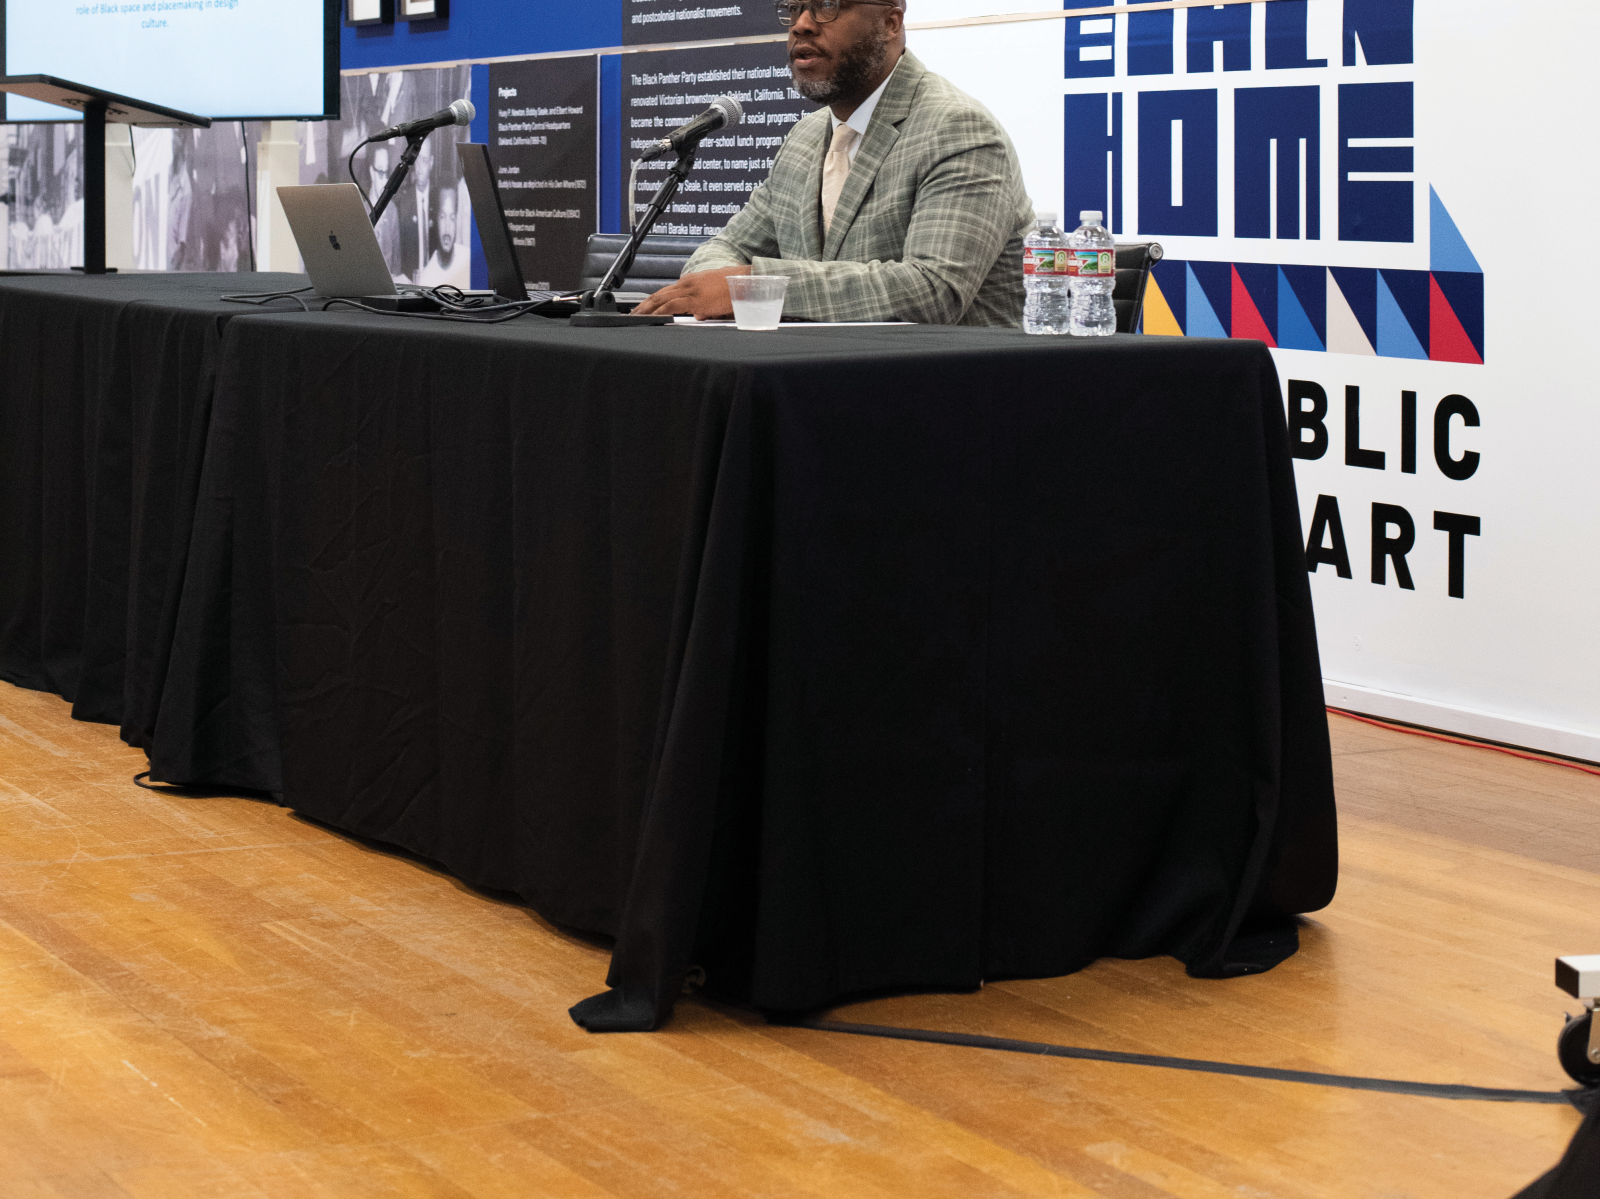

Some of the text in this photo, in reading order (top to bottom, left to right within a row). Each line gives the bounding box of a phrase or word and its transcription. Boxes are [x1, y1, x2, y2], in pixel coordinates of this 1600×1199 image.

[76, 5, 89, 15] role
[92, 4, 99, 14] of
[101, 4, 118, 14] Black
[121, 4, 140, 14] space
[143, 1, 156, 11] and
[158, 0, 203, 12] placemaking
[141, 18, 168, 28] culture.
[631, 74, 642, 85] The
[643, 74, 657, 85] Black
[659, 73, 680, 84] Panther
[681, 71, 696, 85] Party
[698, 69, 731, 82] established
[732, 68, 746, 80] their
[747, 66, 771, 79] national
[631, 95, 658, 106] renovated
[659, 94, 683, 105] Victorian
[754, 88, 784, 101] California.
[631, 117, 652, 128] became
[654, 116, 663, 127] the
[748, 112, 765, 124] social
[737, 135, 753, 146] lunch
[756, 137, 782, 149] program
[649, 160, 666, 169] center
[703, 159, 722, 170] center,
[724, 159, 730, 169] to
[731, 160, 748, 169] name
[748, 157, 760, 172] just
[762, 160, 765, 169] a
[1064, 81, 1414, 243] HOME
[684, 180, 702, 192] Seale,
[703, 180, 708, 191] it
[709, 183, 722, 191] even
[724, 180, 744, 191] served
[745, 182, 752, 192] as
[672, 201, 695, 213] invasion
[698, 202, 709, 213] and
[711, 203, 740, 214] execution.
[653, 223, 667, 234] Amiri
[669, 223, 688, 234] Baraka
[689, 223, 703, 235] later
[1288, 379, 1480, 481] BLIC
[1305, 494, 1481, 599] ART
